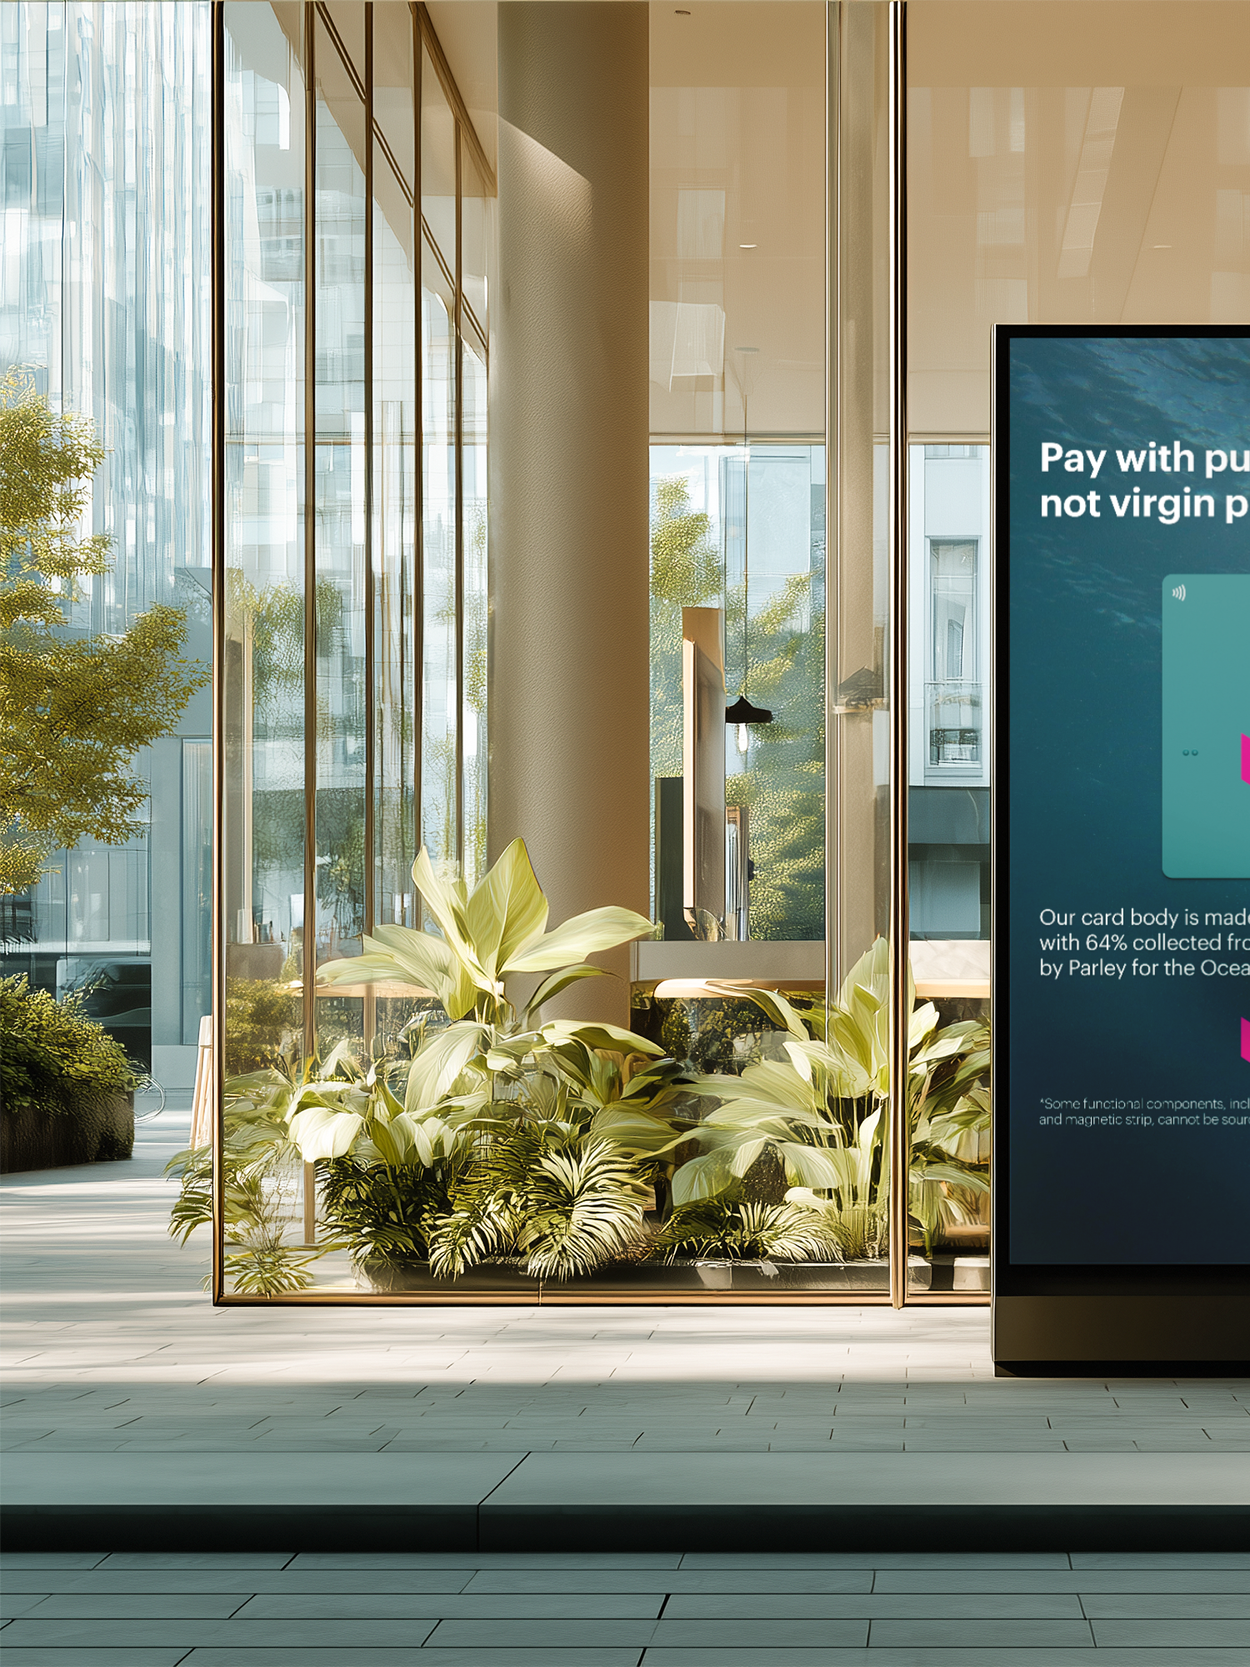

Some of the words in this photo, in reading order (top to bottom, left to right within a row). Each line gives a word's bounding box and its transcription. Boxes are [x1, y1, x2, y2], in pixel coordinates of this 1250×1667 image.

[1040, 441, 1106, 479] Pay
[1115, 440, 1195, 473] with
[1040, 489, 1101, 518] not
[1109, 486, 1215, 525] virgin
[1039, 907, 1076, 926] Our
[1081, 907, 1124, 926] card
[1131, 907, 1179, 930] body
[1185, 908, 1199, 926] is
[1039, 932, 1080, 952] with
[1085, 933, 1128, 952] 64%
[1132, 932, 1222, 952] collected
[1040, 957, 1064, 980] by
[1069, 957, 1127, 980] Parley
[1131, 957, 1159, 976] for
[1163, 957, 1196, 976] the
[1083, 1097, 1144, 1110] functional
[1146, 1099, 1227, 1112] components,
[1039, 1112, 1063, 1126] and
[1065, 1114, 1123, 1128] magnetic
[1125, 1114, 1155, 1128] strip,
[1157, 1115, 1200, 1126] cannot
[1203, 1113, 1219, 1126] be
